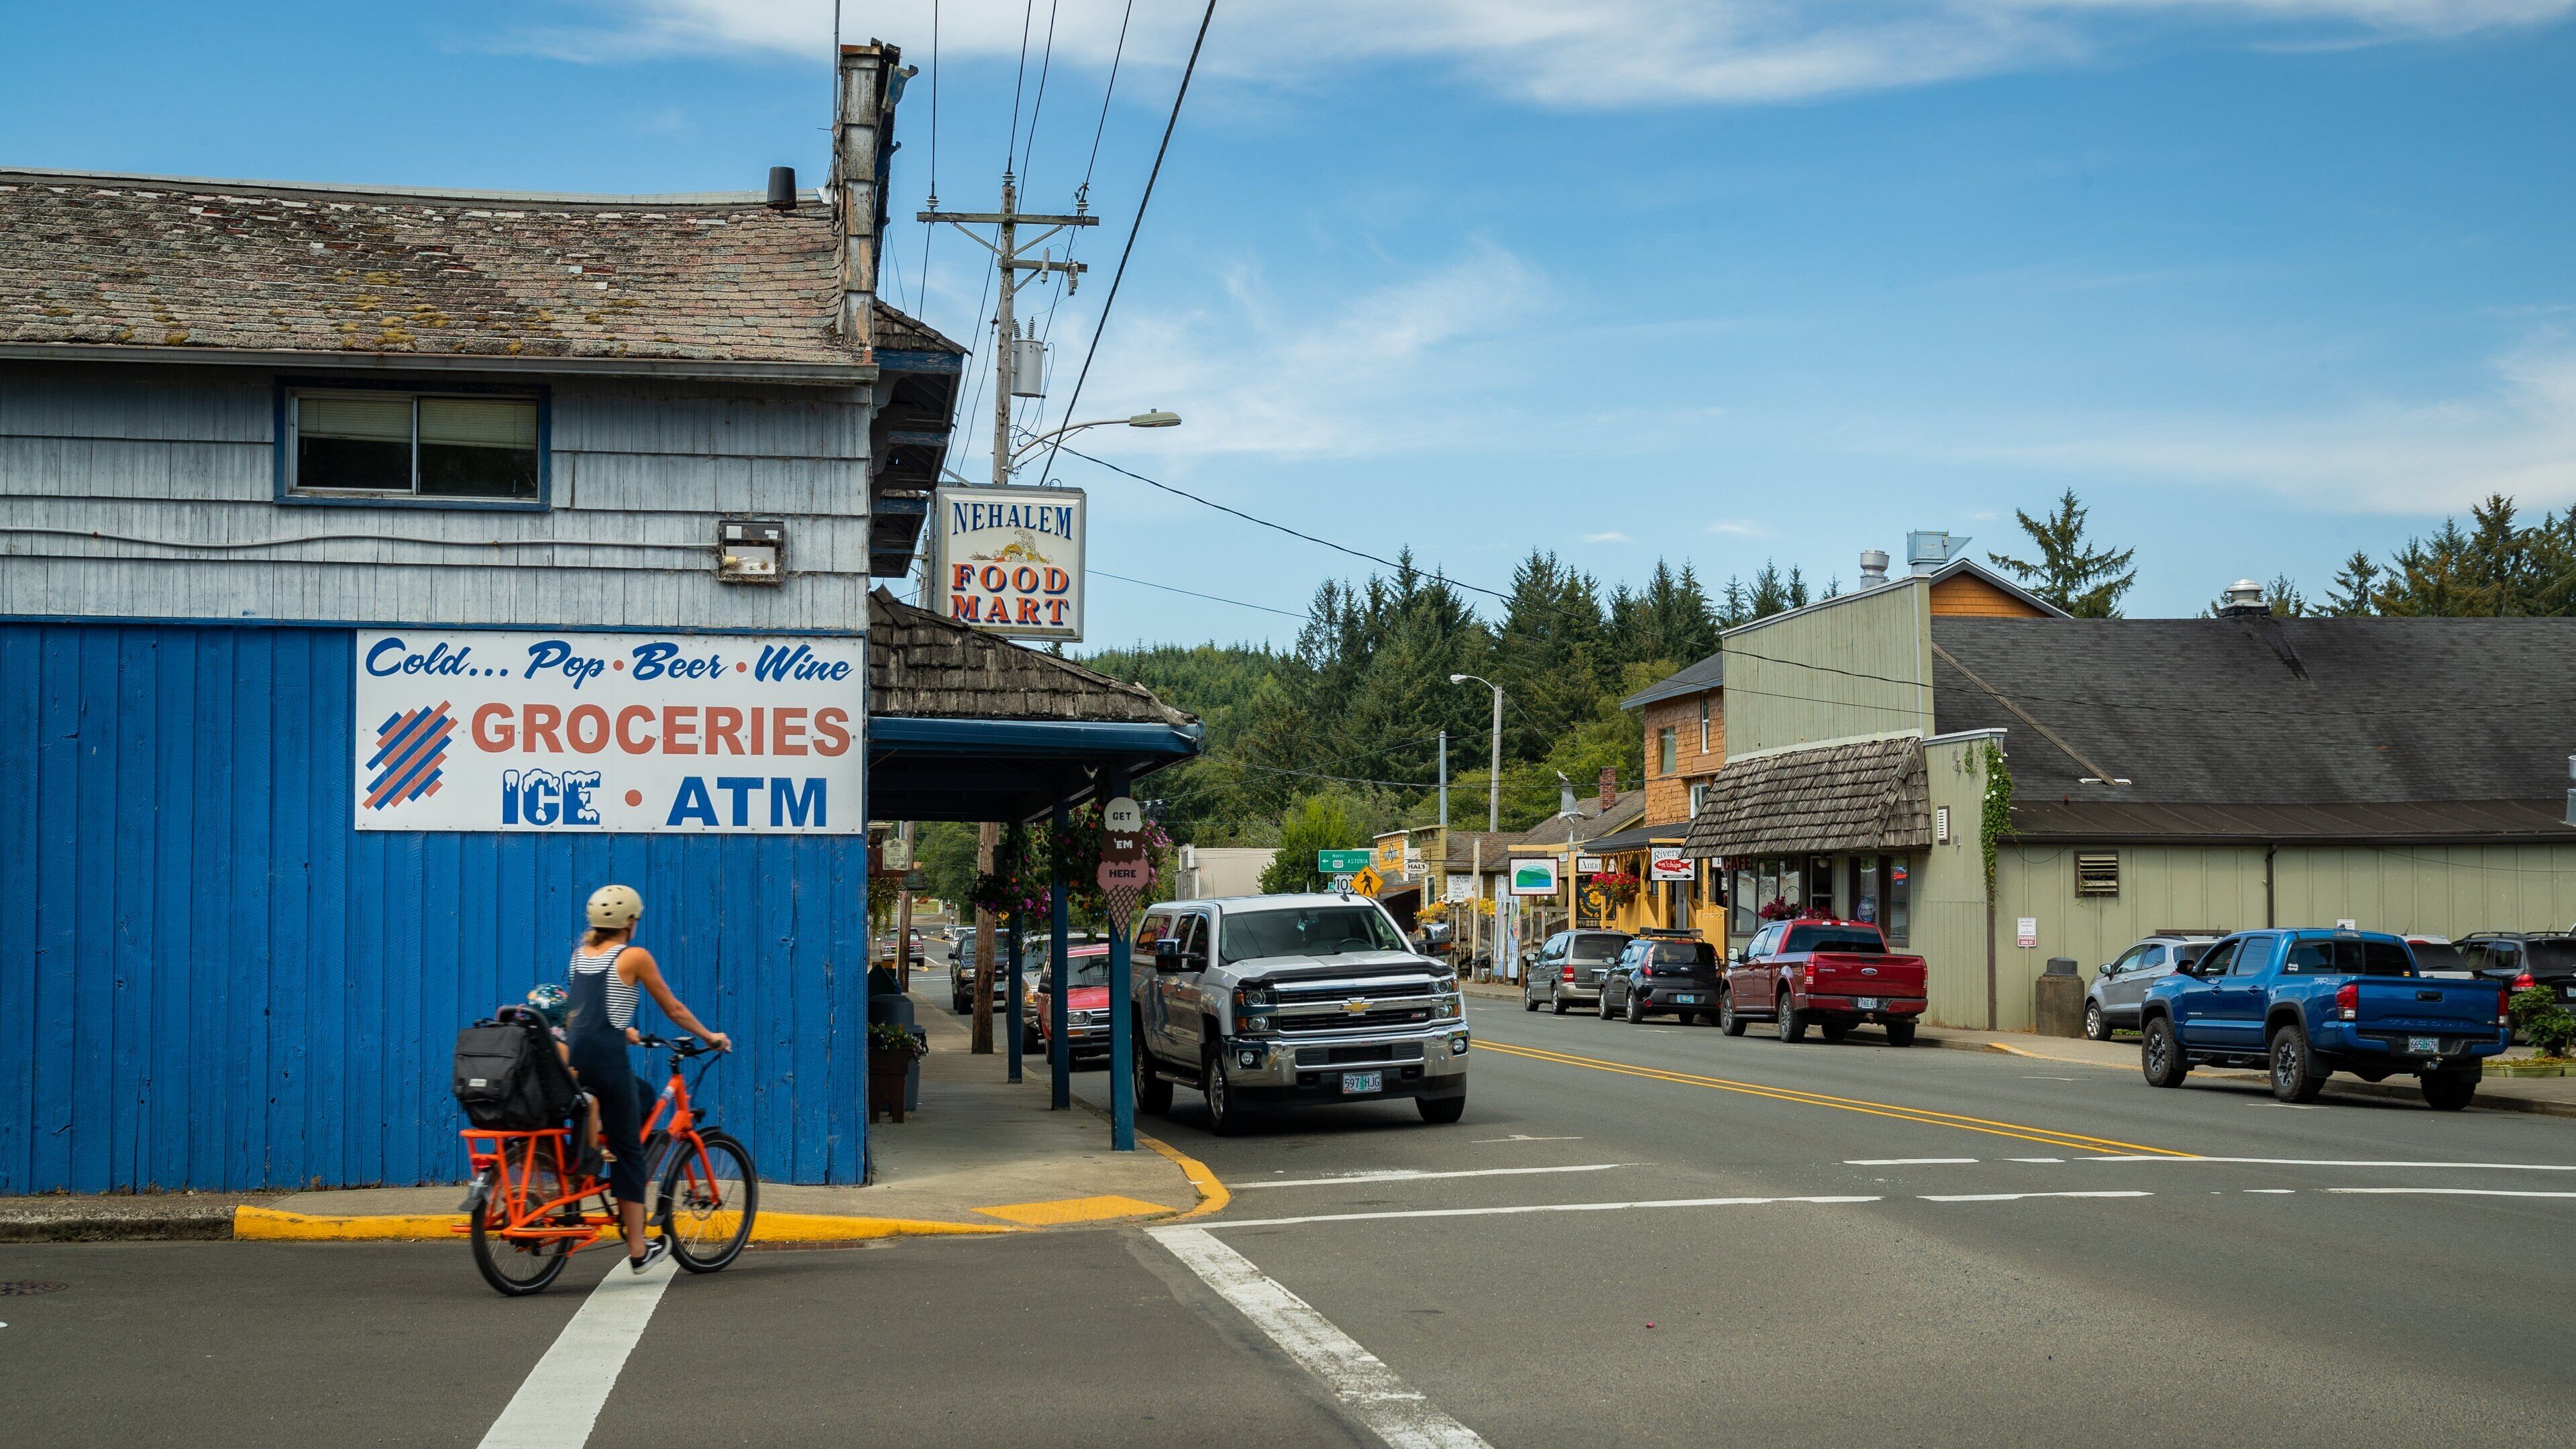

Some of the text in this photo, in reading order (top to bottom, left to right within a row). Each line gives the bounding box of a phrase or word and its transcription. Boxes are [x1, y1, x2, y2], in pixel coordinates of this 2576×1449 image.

[953, 502, 1073, 540] NEHALEM
[952, 564, 1070, 594] FOOD
[951, 594, 1070, 625] MART
[365, 637, 854, 689] Cold... Pop Beer Wine
[471, 702, 851, 757] GROCERIES
[502, 769, 827, 828] ICE ATM
[1112, 812, 1132, 820] GET
[1114, 838, 1133, 849] 'EM
[1654, 849, 1681, 861] Rivers
[1580, 860, 1613, 871] Antiqs
[1723, 856, 1751, 871] CAFE
[1109, 869, 1136, 878] HERE
[1336, 879, 1352, 891] 101
[2388, 1019, 2469, 1028] TACOMA
[2410, 1040, 2438, 1049] 665 HZH
[1344, 1076, 1380, 1089] 597 HJG
